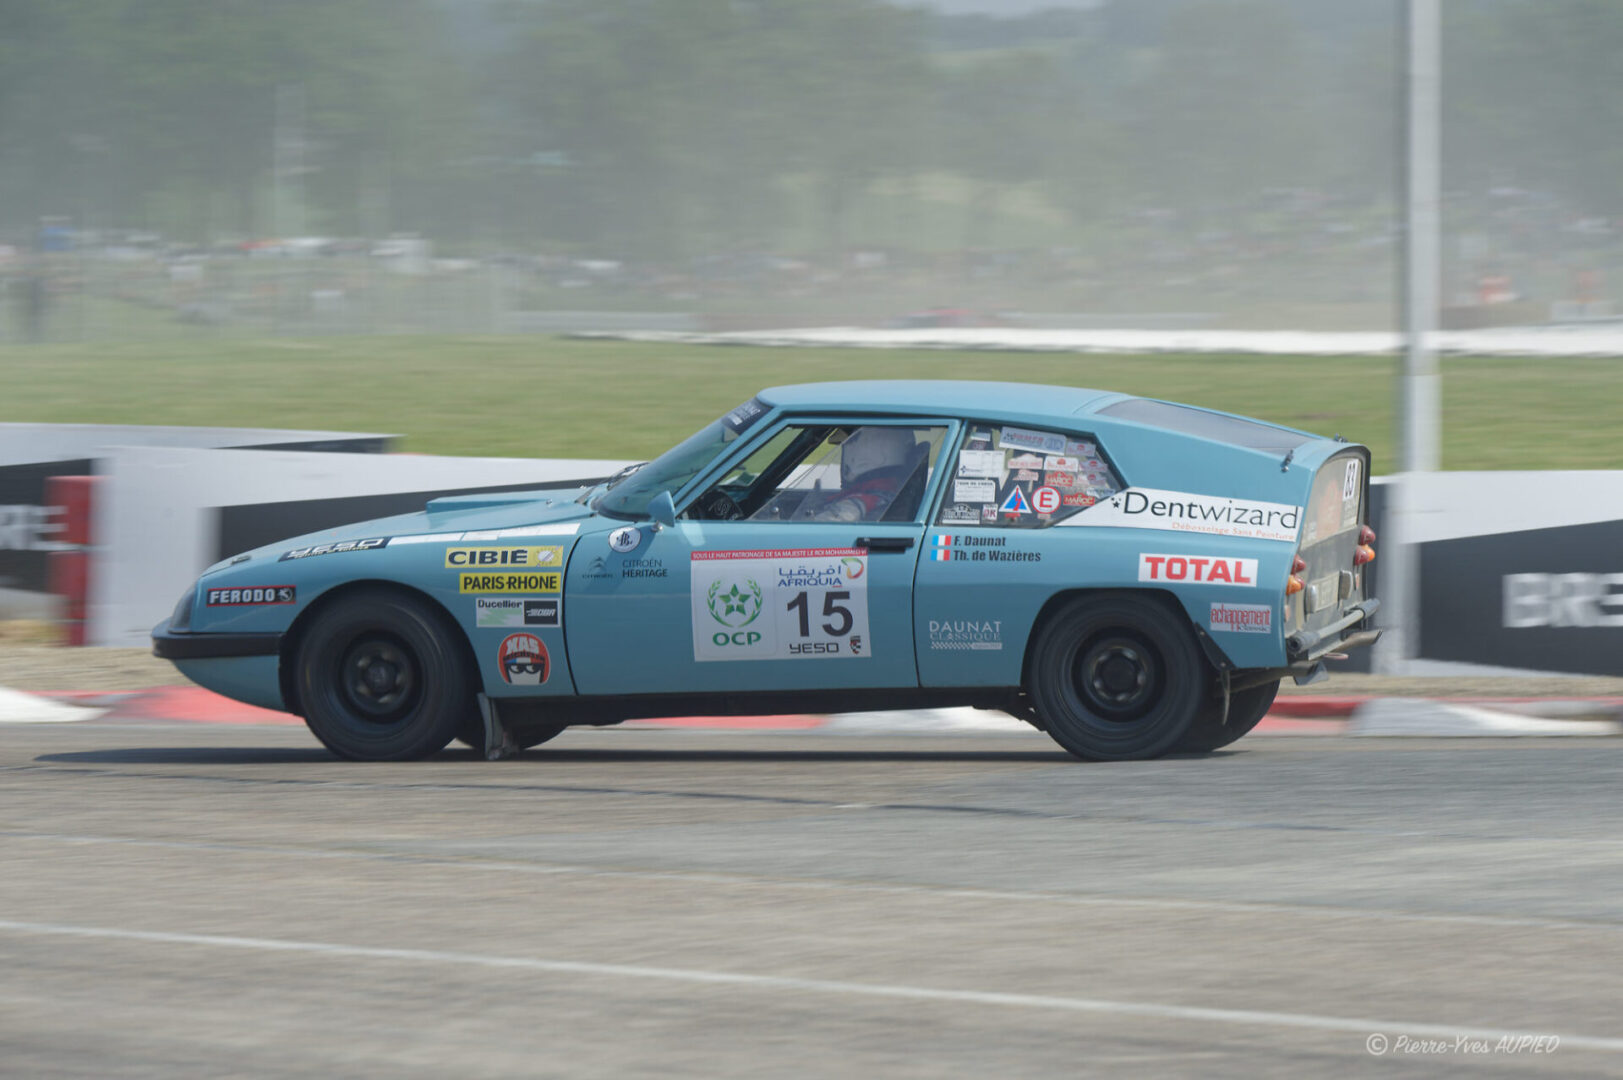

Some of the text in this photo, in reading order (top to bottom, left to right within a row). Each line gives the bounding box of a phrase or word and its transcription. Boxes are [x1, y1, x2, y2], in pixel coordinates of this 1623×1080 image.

[1039, 491, 1053, 508] E
[1064, 496, 1094, 505] MAROC
[1123, 491, 1298, 529] Dentwizard
[1233, 527, 1252, 537] Sans
[1256, 529, 1294, 540] Peinture
[954, 535, 1006, 547] F. Daunat
[953, 550, 1041, 562] Th. de Wazières
[622, 558, 662, 568] CITROËN
[622, 568, 668, 578] HERITAGE
[1145, 556, 1251, 583] TOTAL
[463, 575, 557, 590] PARIS-RHONE
[778, 577, 842, 587] AFRIQUIA
[209, 588, 275, 604] FERODO
[478, 599, 522, 608] Ducellier
[787, 591, 853, 637] 15
[929, 620, 1002, 632] DAUNAT
[712, 631, 762, 647] OCP
[930, 632, 1000, 641] CLASSIQUE
[789, 642, 839, 654] YESO
